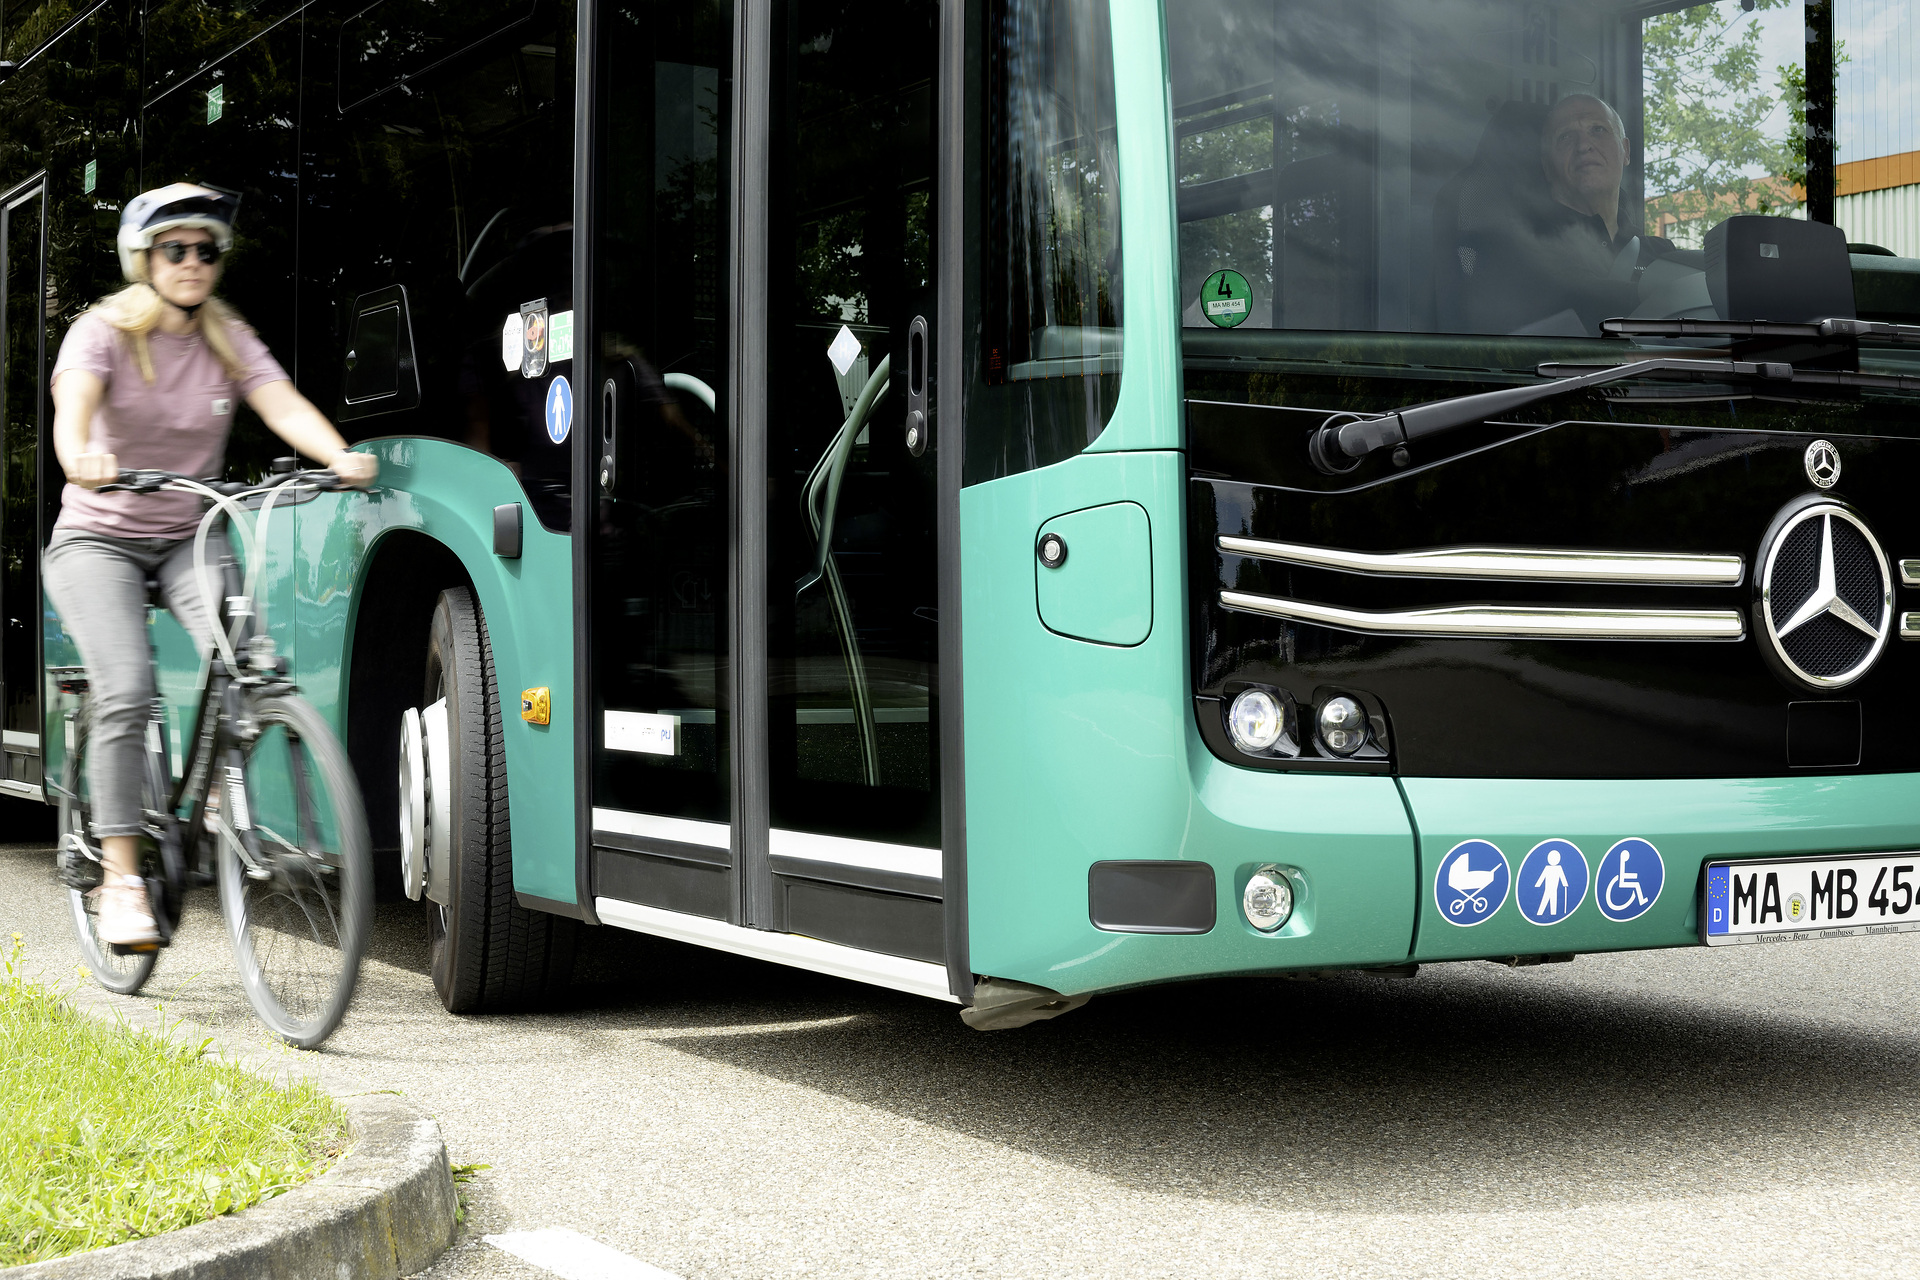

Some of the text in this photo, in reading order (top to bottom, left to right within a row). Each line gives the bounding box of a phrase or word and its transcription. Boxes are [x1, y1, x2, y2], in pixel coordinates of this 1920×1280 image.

[1218, 272, 1232, 298] 4
[1713, 907, 1722, 922] D
[1733, 872, 1783, 925] MA
[1811, 869, 1858, 921] MB
[1868, 865, 1920, 916] 45
[1756, 933, 1787, 943] Mercedes
[1793, 932, 1810, 941] Benz
[1819, 928, 1855, 938] Omnibusse
[1865, 925, 1899, 935] Mannheim
